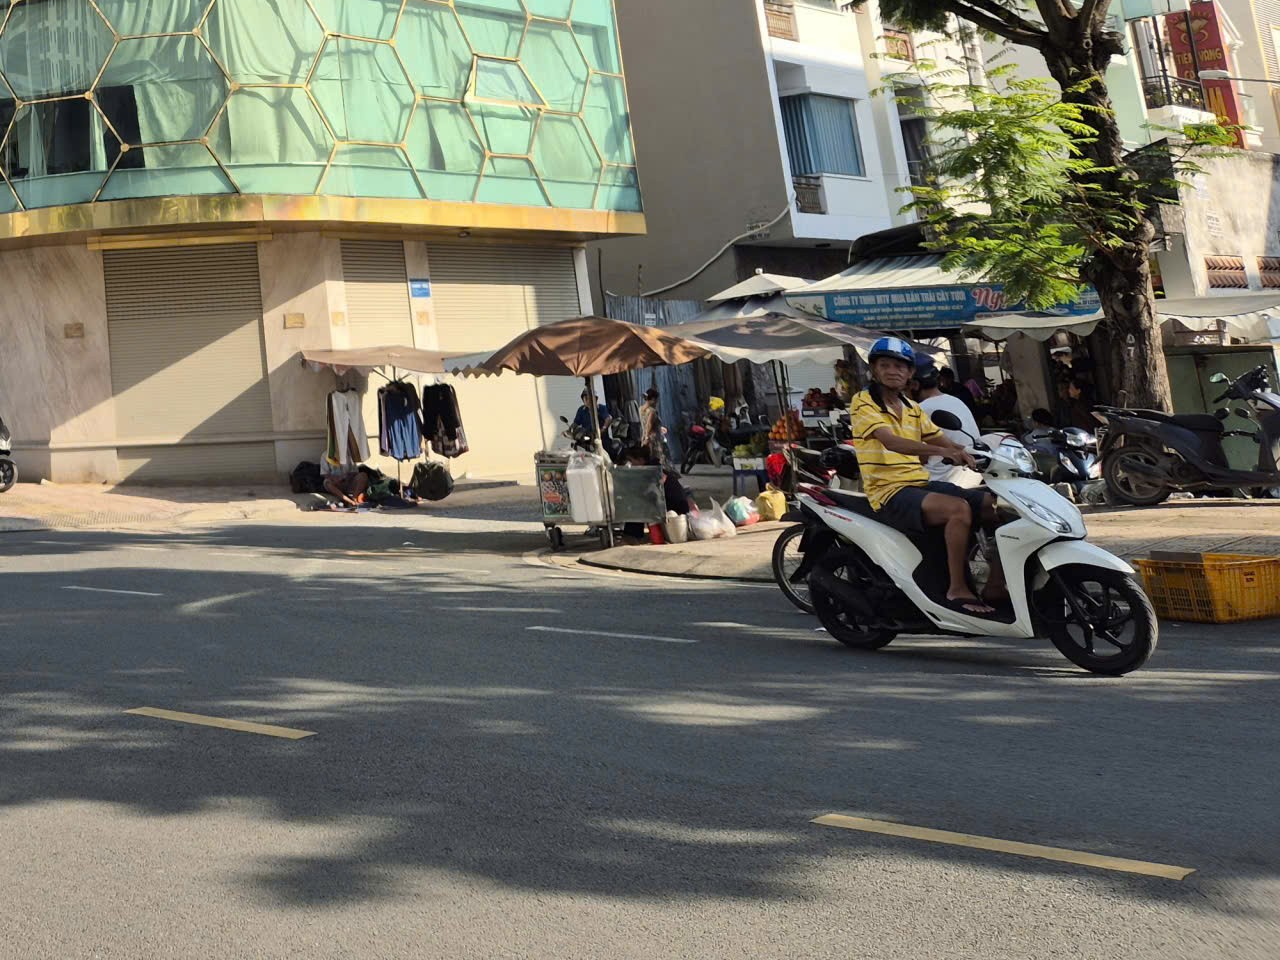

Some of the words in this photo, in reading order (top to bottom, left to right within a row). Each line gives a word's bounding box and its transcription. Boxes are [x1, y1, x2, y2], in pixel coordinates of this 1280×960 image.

[833, 295, 850, 307] CÔNG
[851, 295, 859, 305] TY
[920, 291, 936, 302] TRÁI
[936, 290, 950, 302] CÂY
